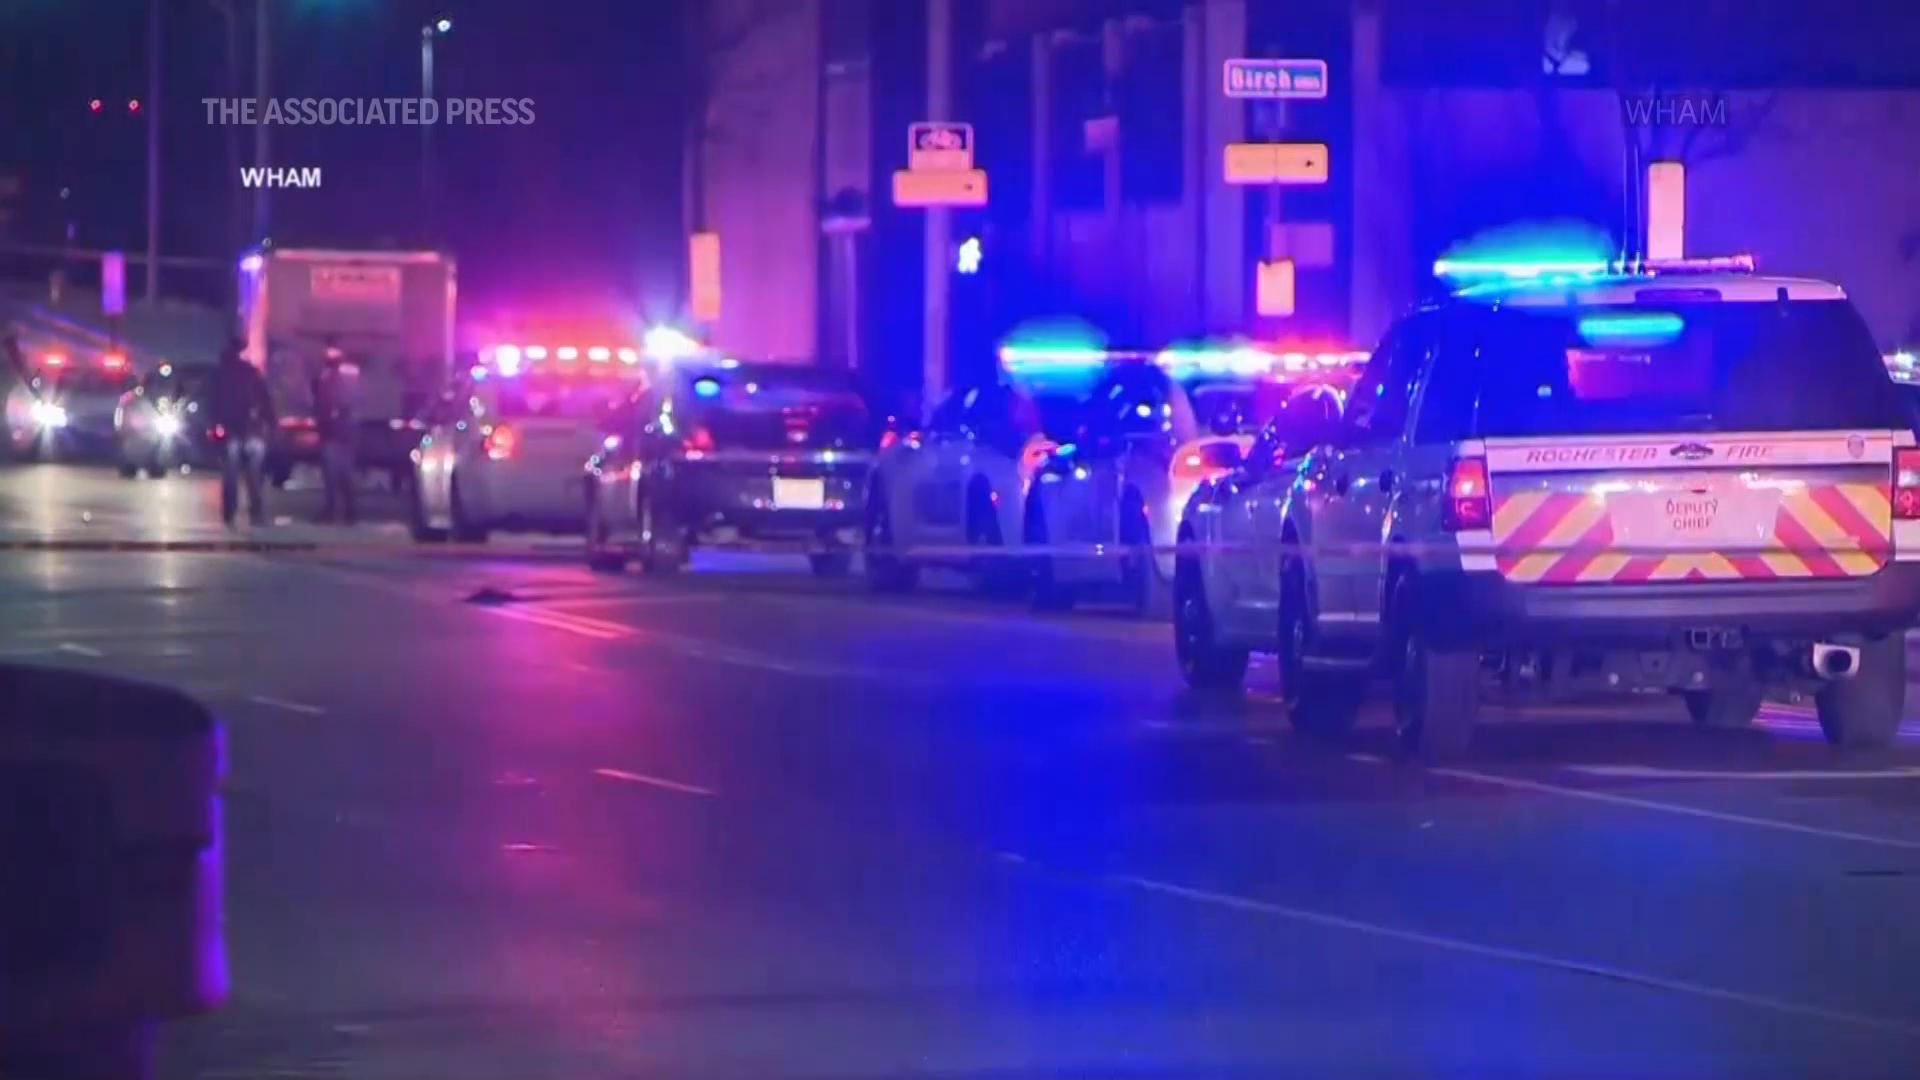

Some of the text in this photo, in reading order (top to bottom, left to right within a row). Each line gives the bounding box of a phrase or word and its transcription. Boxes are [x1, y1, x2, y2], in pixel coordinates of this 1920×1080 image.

[1231, 66, 1291, 90] Birch
[1526, 445, 1774, 463] ROCHESTER FIRE
[1666, 498, 1718, 515] DEPUTY
[1673, 517, 1713, 530] CHIEF
